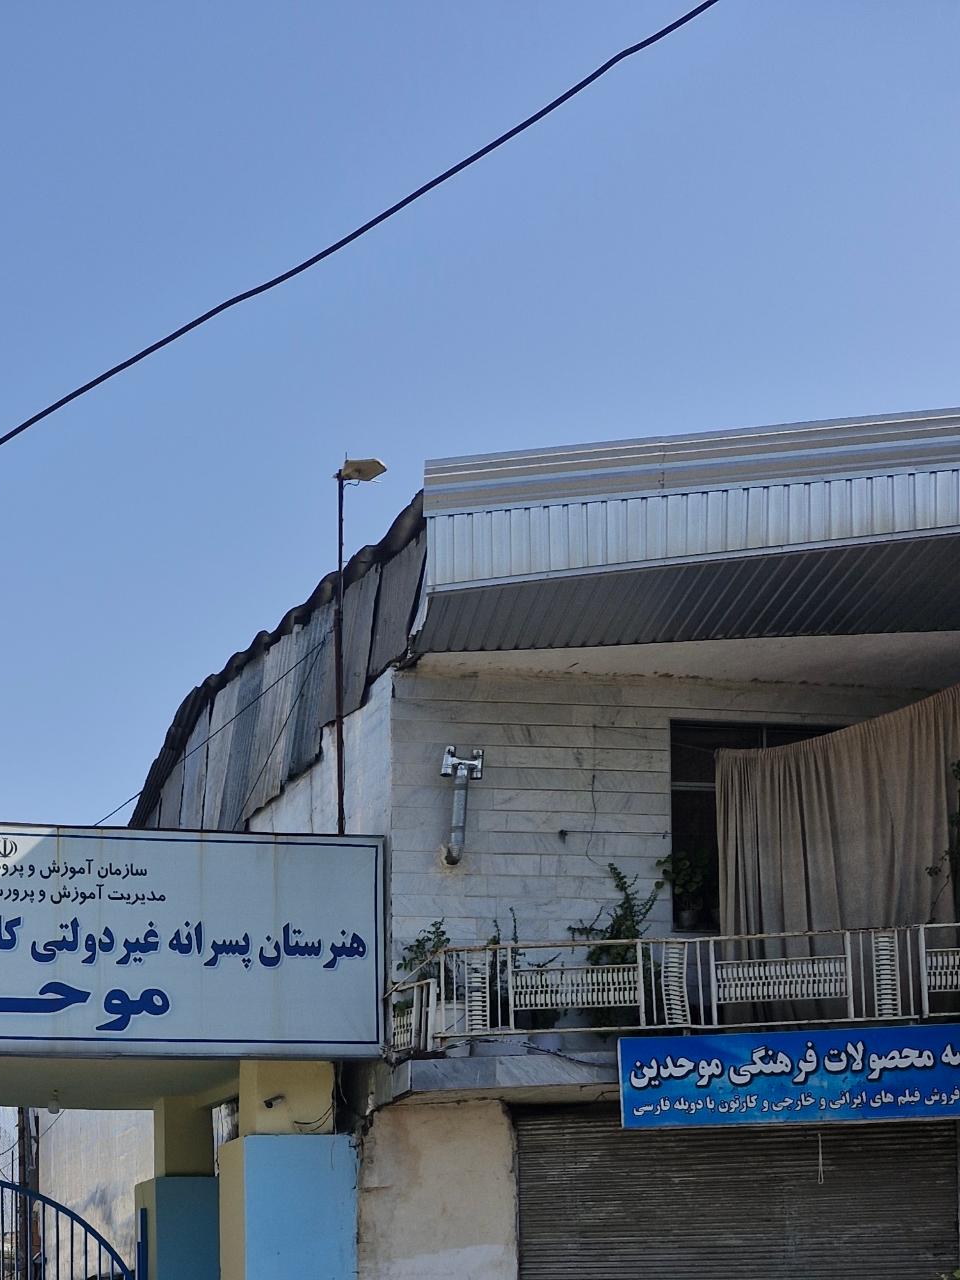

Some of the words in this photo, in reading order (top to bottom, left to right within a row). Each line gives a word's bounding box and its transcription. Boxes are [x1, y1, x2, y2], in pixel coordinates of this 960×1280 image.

[27, 864, 36, 878] و
[39, 859, 94, 880] آموزش
[97, 863, 148, 880] سازمان
[38, 889, 46, 903] و
[50, 884, 104, 904] آموزش
[107, 890, 167, 905] مدیریت
[168, 920, 251, 969] پسرانه
[258, 922, 367, 969] هنرستان
[729, 1041, 818, 1085] فرهنگی
[823, 1041, 934, 1080] محصولات
[630, 1055, 723, 1088] موحدین
[705, 1096, 715, 1111] با
[718, 1095, 758, 1113] کارتون
[772, 1092, 816, 1112] خارجی
[819, 1098, 826, 1110] و
[829, 1090, 867, 1108] ایرانی
[869, 1090, 894, 1107] های
[897, 1088, 921, 1107] فیلم
[924, 1086, 960, 1105] فروش
[633, 1097, 671, 1116] فارسی
[673, 1097, 703, 1114] دوبله
[762, 1101, 769, 1112] و
